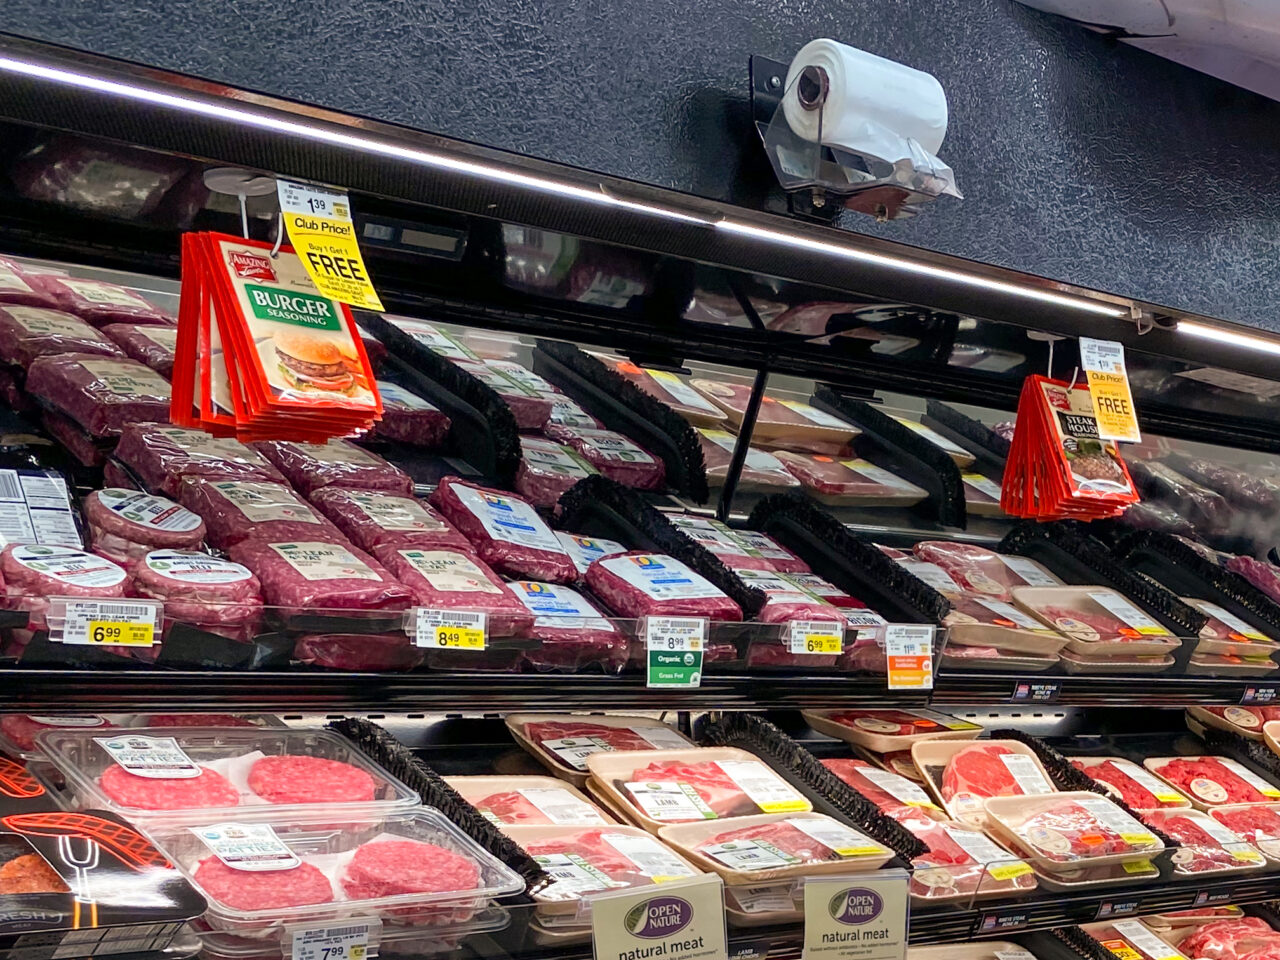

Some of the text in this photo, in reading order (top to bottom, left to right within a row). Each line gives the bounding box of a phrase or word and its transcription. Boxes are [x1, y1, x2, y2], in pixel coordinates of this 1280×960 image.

[307, 198, 326, 213] 139
[295, 218, 350, 235] Club Price!
[308, 243, 322, 252] Buy
[330, 246, 343, 254] Get
[233, 254, 271, 270] AMAZING
[306, 252, 366, 281] FREE
[252, 290, 331, 317] BURGER
[267, 308, 326, 325] SEASONING
[1092, 374, 1105, 382] Club
[1097, 397, 1130, 415] FREE
[1066, 416, 1094, 426] STEAK
[93, 626, 121, 642] 699
[438, 632, 459, 646] 849
[668, 637, 684, 650] 899
[807, 639, 822, 653] 699
[657, 654, 681, 663] Organic
[734, 853, 759, 861] LAMB
[848, 894, 875, 907] OPEN
[649, 903, 681, 918] OPEN
[848, 903, 875, 917] NATURE
[649, 913, 682, 929] NATURE
[822, 928, 889, 943] natural meat
[670, 935, 704, 953] meat
